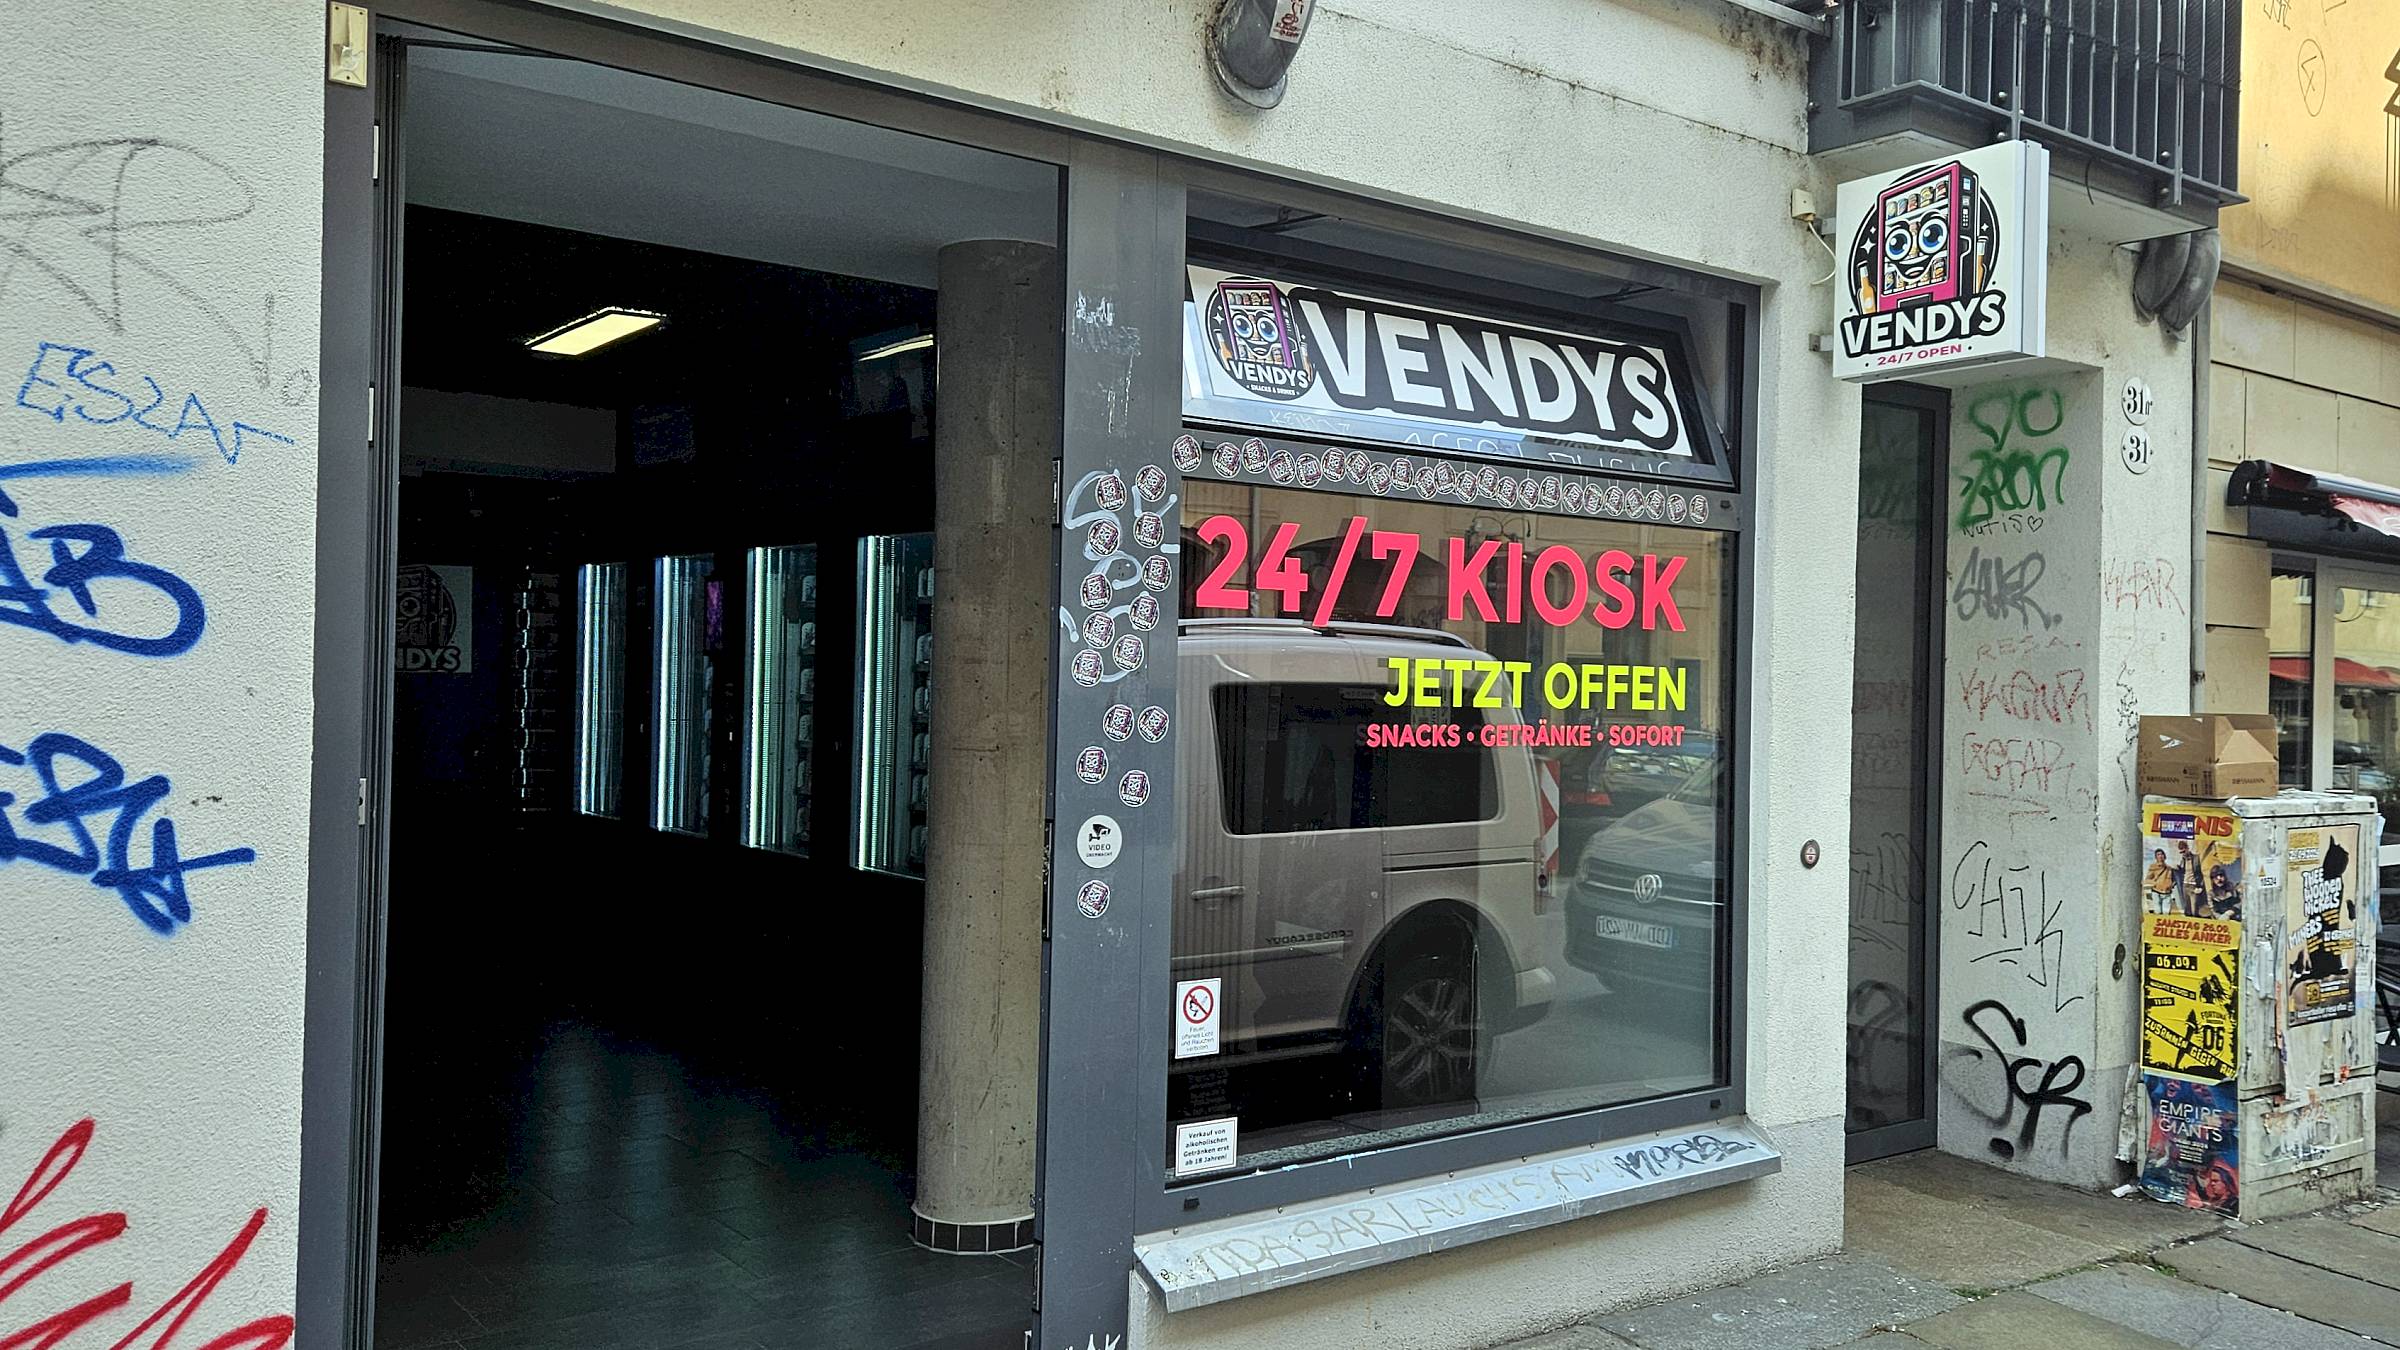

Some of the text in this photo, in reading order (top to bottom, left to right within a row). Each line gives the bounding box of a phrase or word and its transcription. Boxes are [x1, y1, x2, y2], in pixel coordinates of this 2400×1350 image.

[1843, 294, 2002, 354] VENDYS
[1878, 344, 1961, 366] 24/7 OPEN
[1229, 360, 1308, 388] VENDYS
[1299, 299, 1670, 439] VENDYS
[2129, 435, 2147, 464] 31
[1197, 516, 1687, 631] 24/7 KIOSK
[1384, 657, 1686, 710] JETZT OFFEN
[1366, 718, 1684, 747] SNACKS GETRÄNKE SOFORT
[2153, 927, 2232, 945] ZILLES ANKER
[2155, 919, 2200, 931] SAMSTAG
[2156, 955, 2196, 970] 06.09.
[1188, 1130, 1212, 1138] Verkauf
[2159, 1116, 2223, 1142] GIANTS
[1183, 1148, 1216, 1158] Getränken
[1185, 1137, 1228, 1149] alkoholischen
